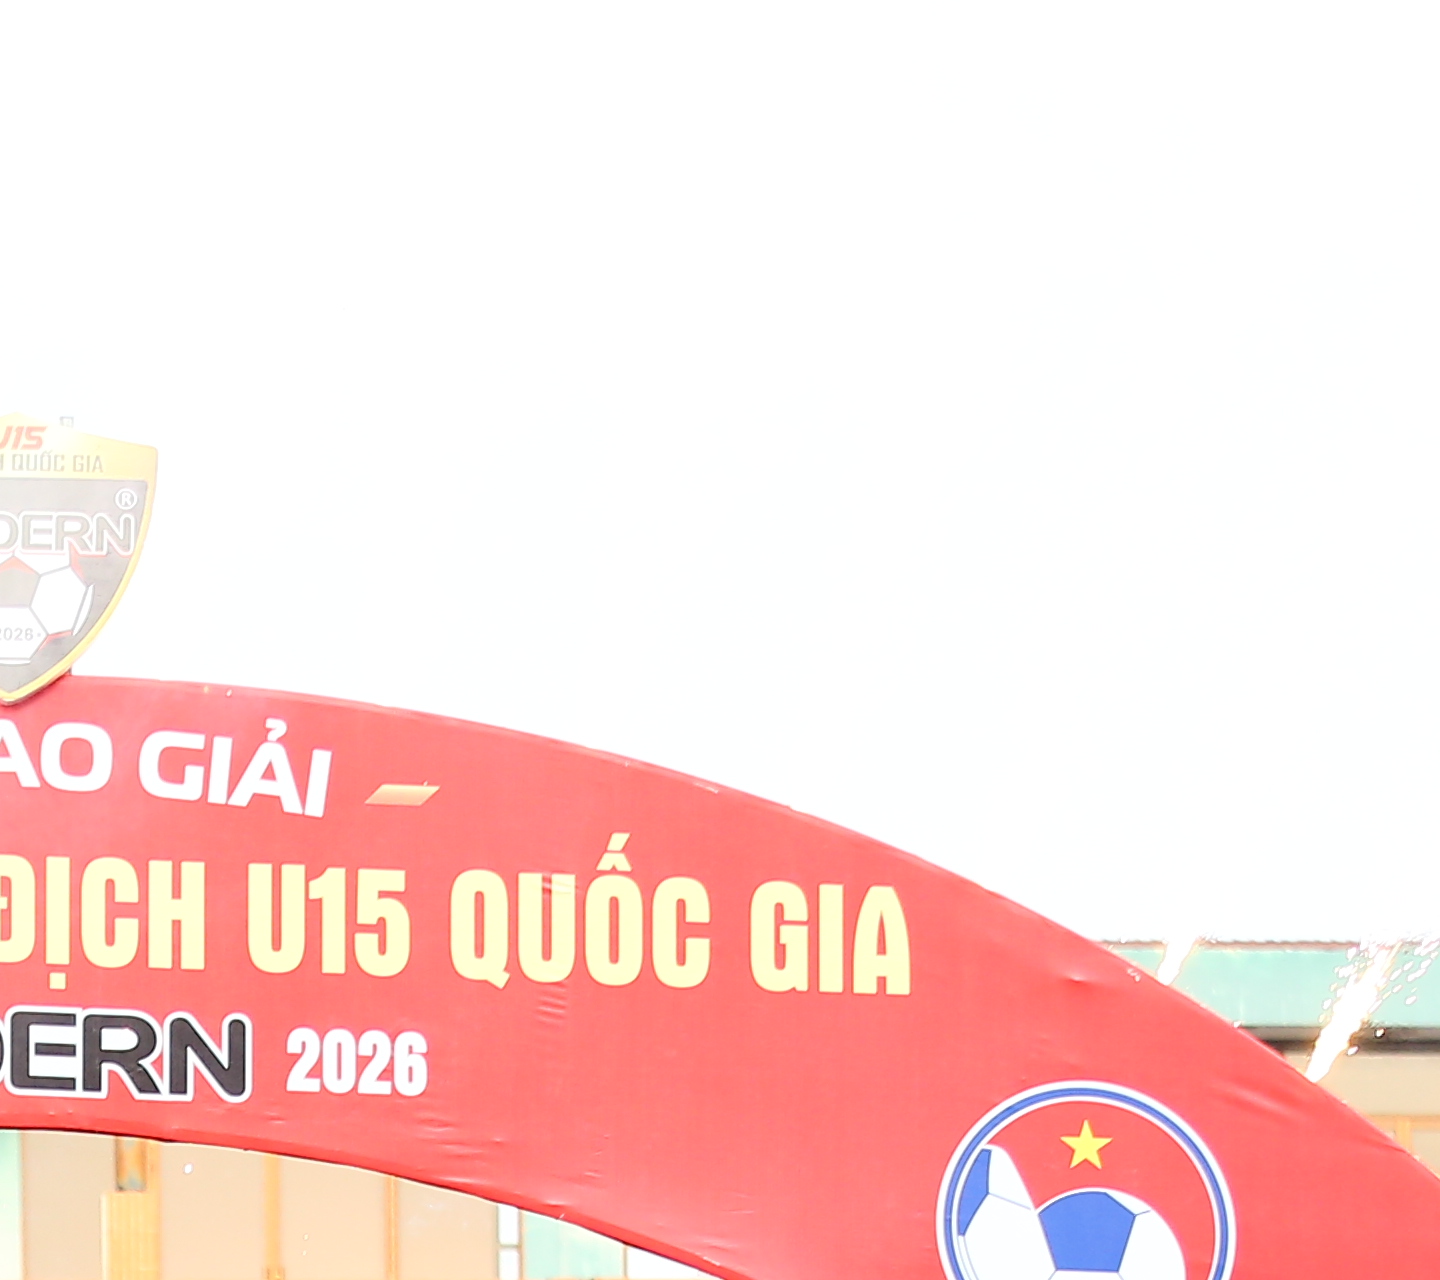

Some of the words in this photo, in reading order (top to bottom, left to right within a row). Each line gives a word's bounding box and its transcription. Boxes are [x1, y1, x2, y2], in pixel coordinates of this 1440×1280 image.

[12, 450, 65, 472] QUỐC
[73, 454, 104, 473] GIA
[137, 716, 334, 818] GIẢI
[247, 862, 412, 978] U15
[449, 831, 712, 990] QUỐC
[749, 879, 912, 996] GIA
[285, 1027, 429, 1097] 2026
